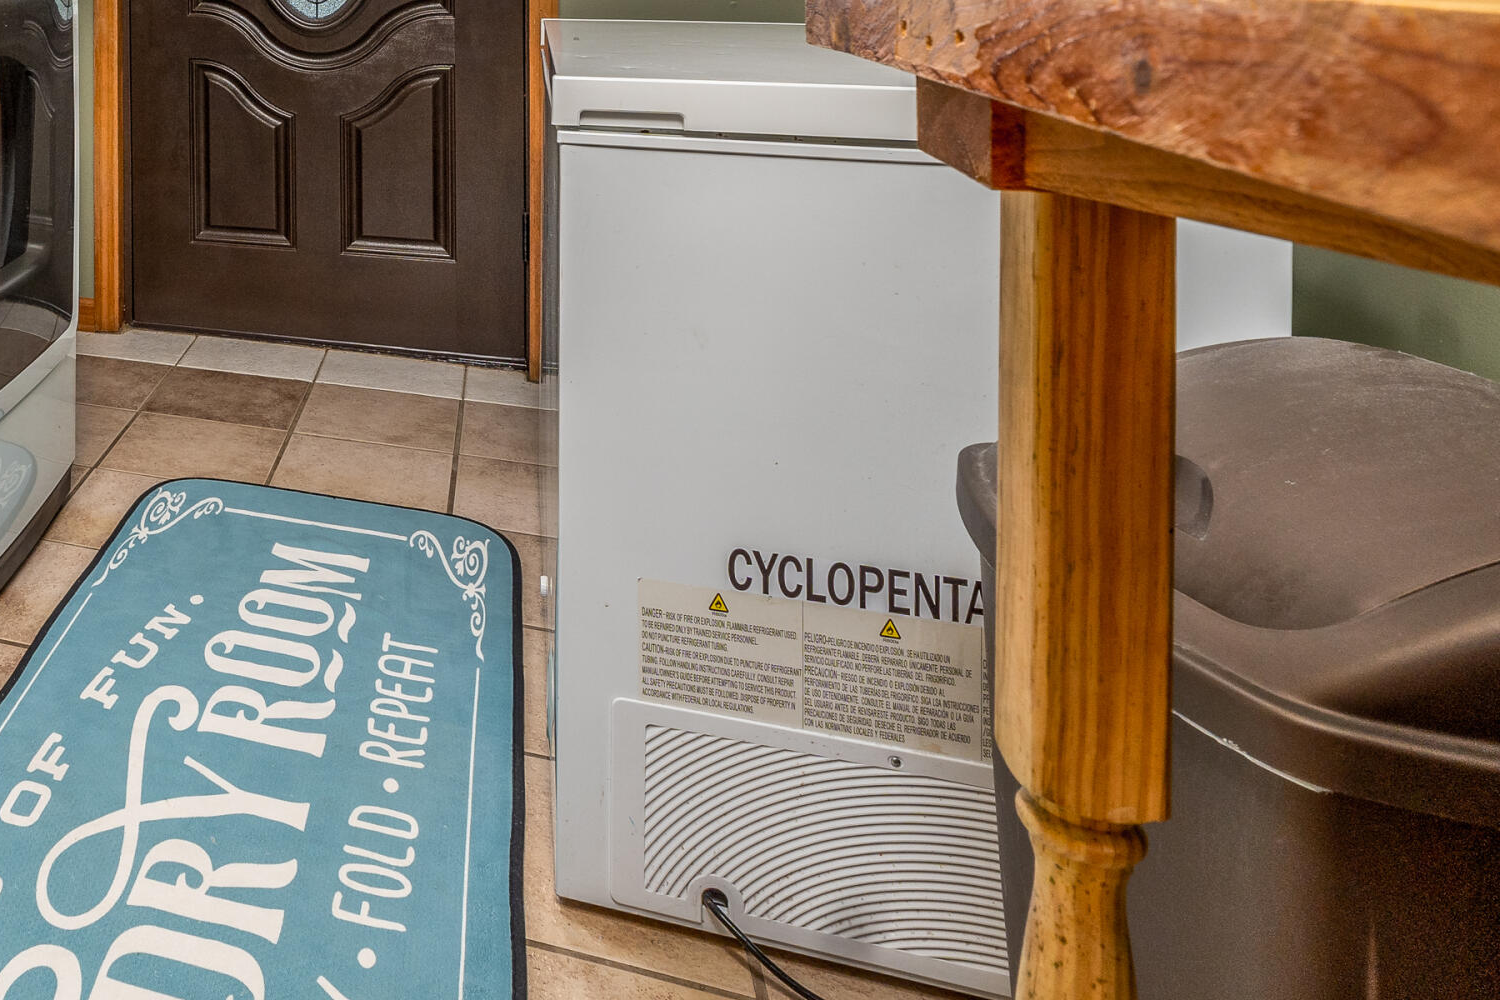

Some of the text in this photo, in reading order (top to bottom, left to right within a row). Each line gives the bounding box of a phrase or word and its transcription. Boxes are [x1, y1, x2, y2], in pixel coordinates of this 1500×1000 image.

[197, 542, 370, 758] ROOM
[641, 606, 662, 619] DANGER
[665, 610, 676, 621] RISK
[676, 611, 682, 622] OF
[683, 612, 693, 624] FIRE
[693, 614, 700, 625] OR
[675, 647, 681, 657] OF
[681, 648, 692, 659] FIRE
[733, 656, 739, 666] TO
[763, 660, 770, 671] OF
[770, 662, 801, 676] REFRIGERANT
[686, 626, 692, 635] BY
[359, 632, 439, 769] REPEAT
[0, 732, 69, 827] OF
[332, 805, 419, 932] FOLD
